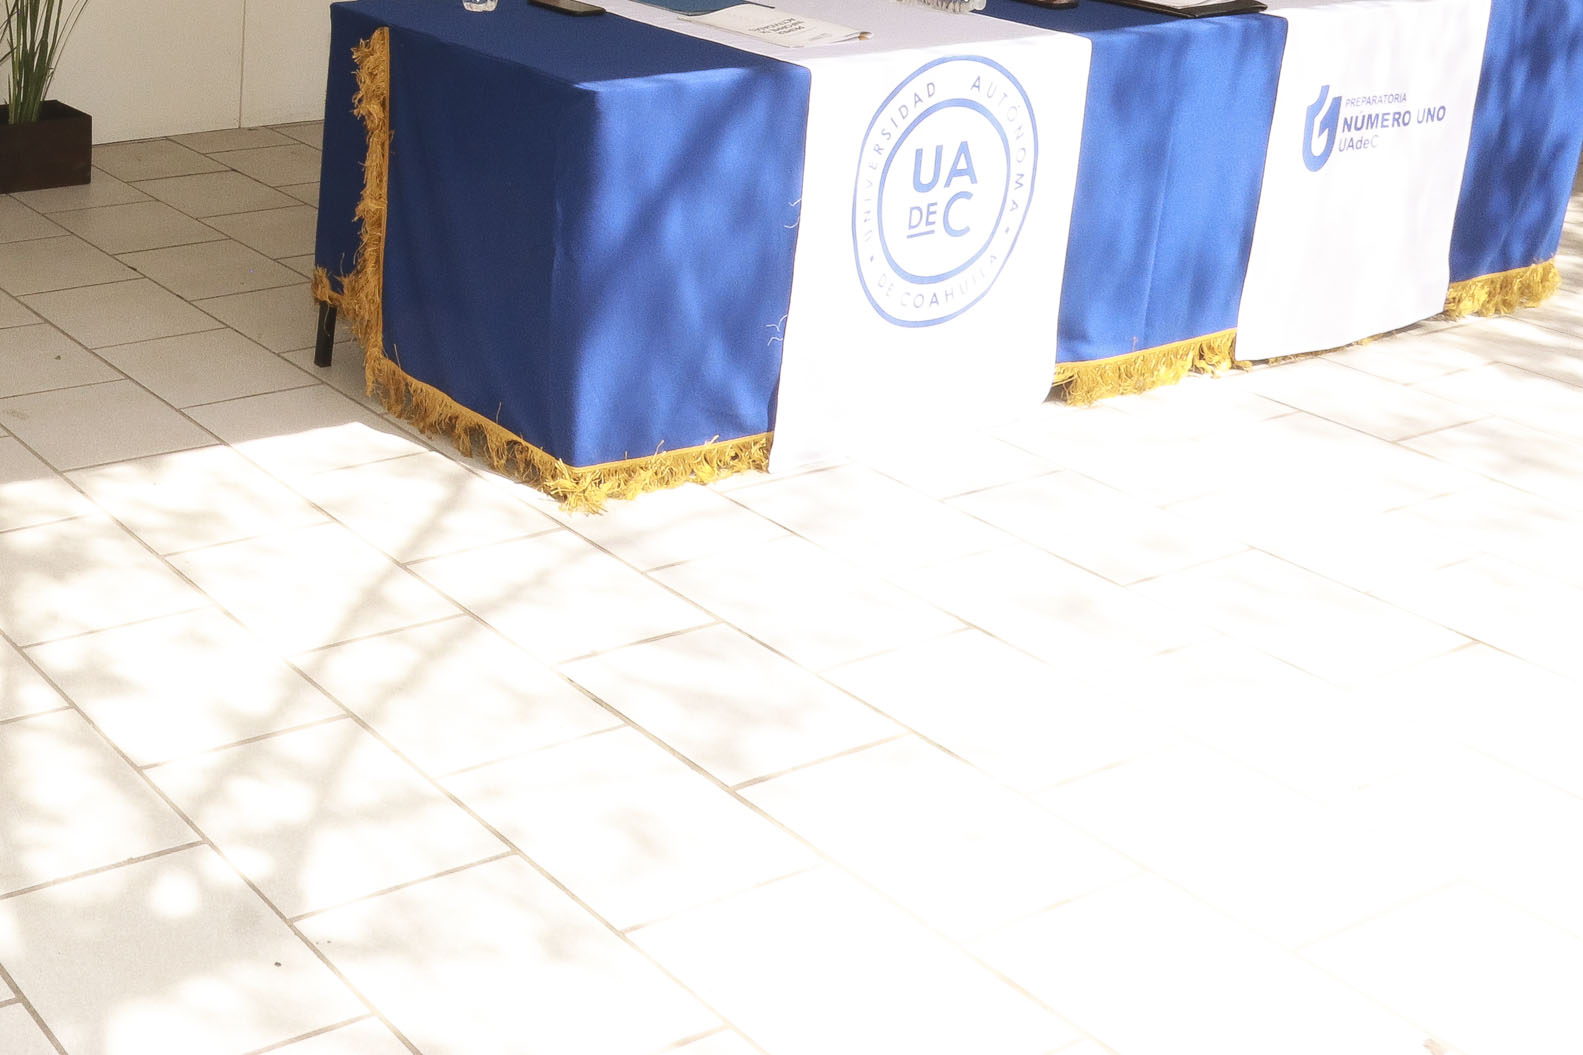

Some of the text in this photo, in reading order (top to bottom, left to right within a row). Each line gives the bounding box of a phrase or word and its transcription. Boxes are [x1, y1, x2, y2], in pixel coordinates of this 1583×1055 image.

[1344, 92, 1408, 107] PREPARATORIA
[1416, 105, 1447, 124] UNO
[1338, 134, 1380, 153] UAdeC
[863, 80, 937, 244] UNIVERSIDAD
[911, 140, 979, 194] UA
[907, 190, 975, 239] DE C
